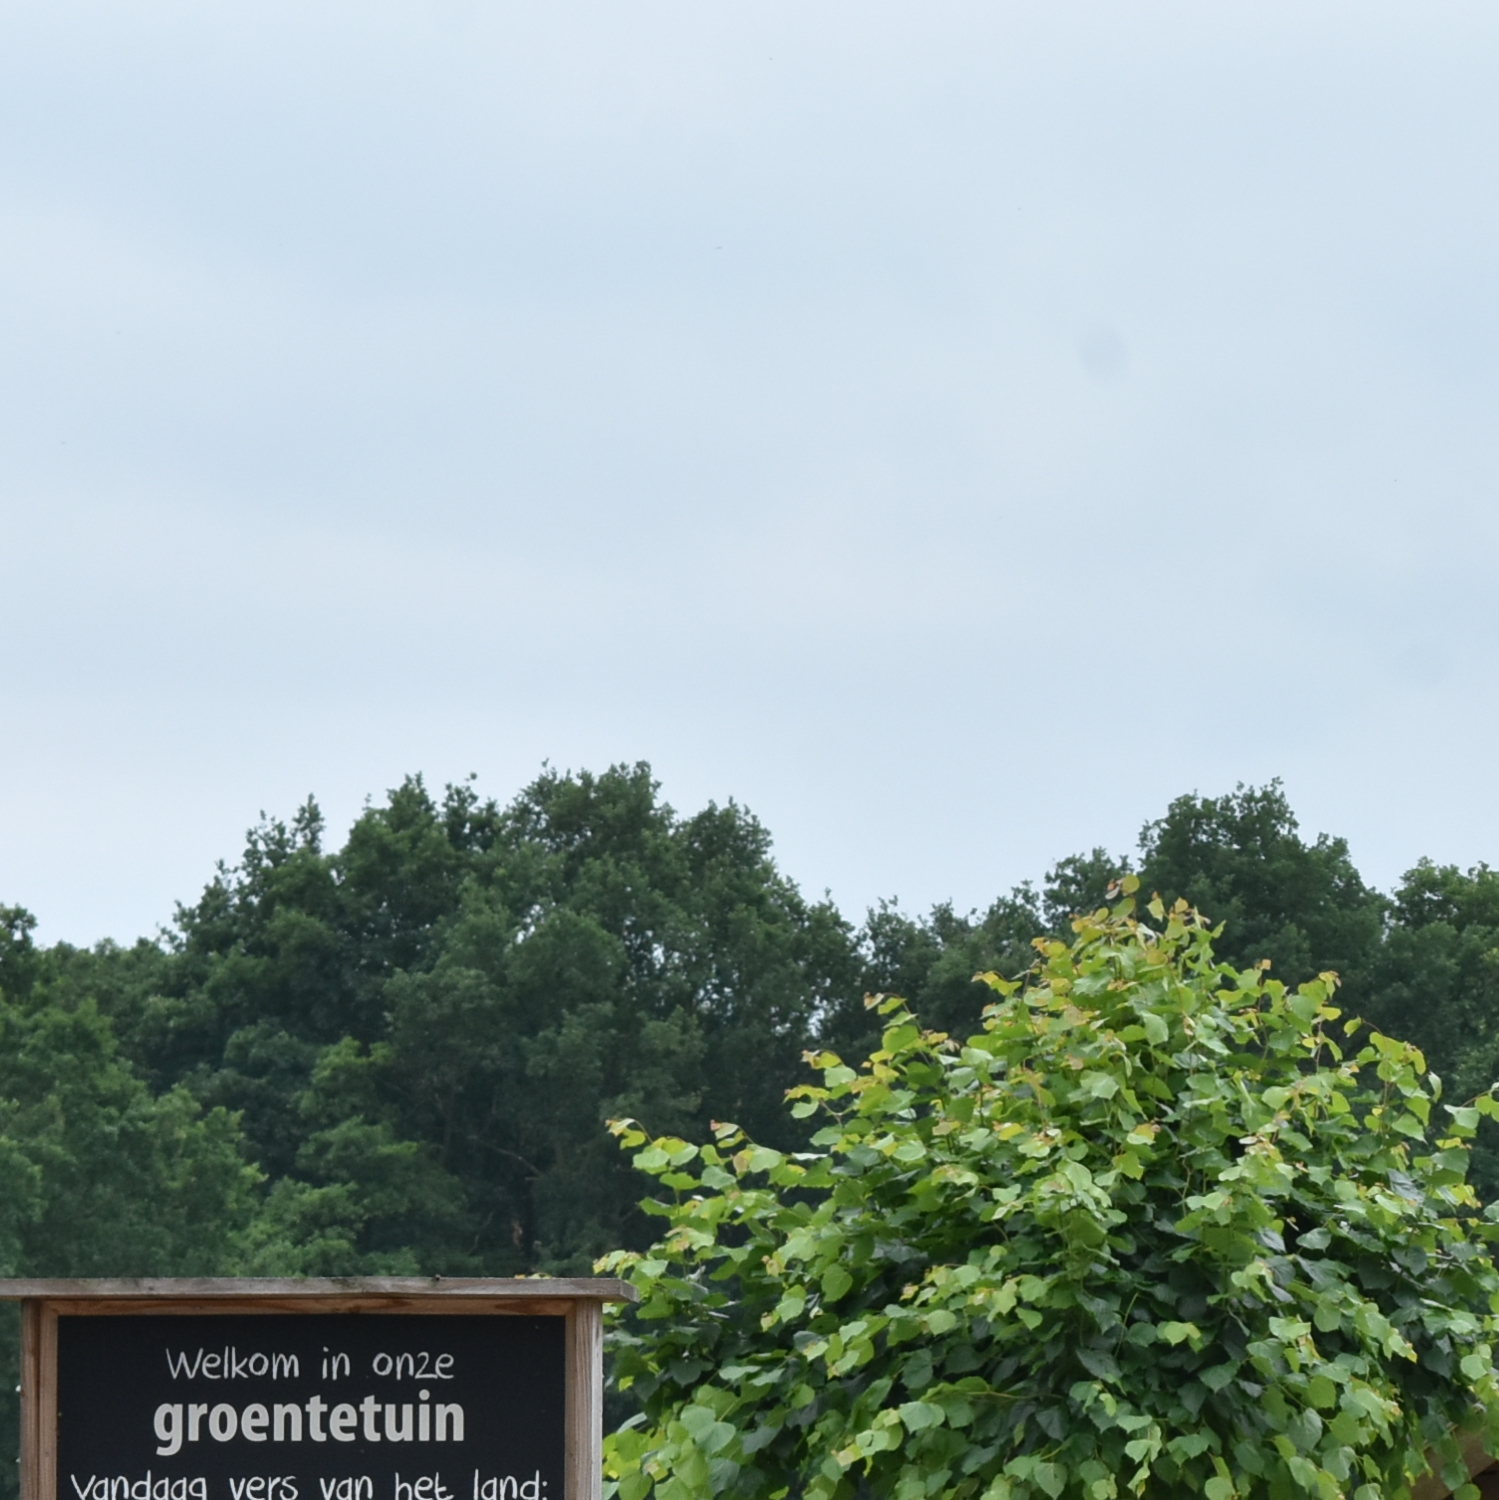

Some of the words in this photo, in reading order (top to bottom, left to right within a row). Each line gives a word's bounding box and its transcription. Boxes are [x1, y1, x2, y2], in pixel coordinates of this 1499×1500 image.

[166, 1346, 300, 1380] Welkom
[322, 1347, 350, 1380] in
[373, 1352, 454, 1380] onze
[153, 1389, 465, 1456] groentetuin
